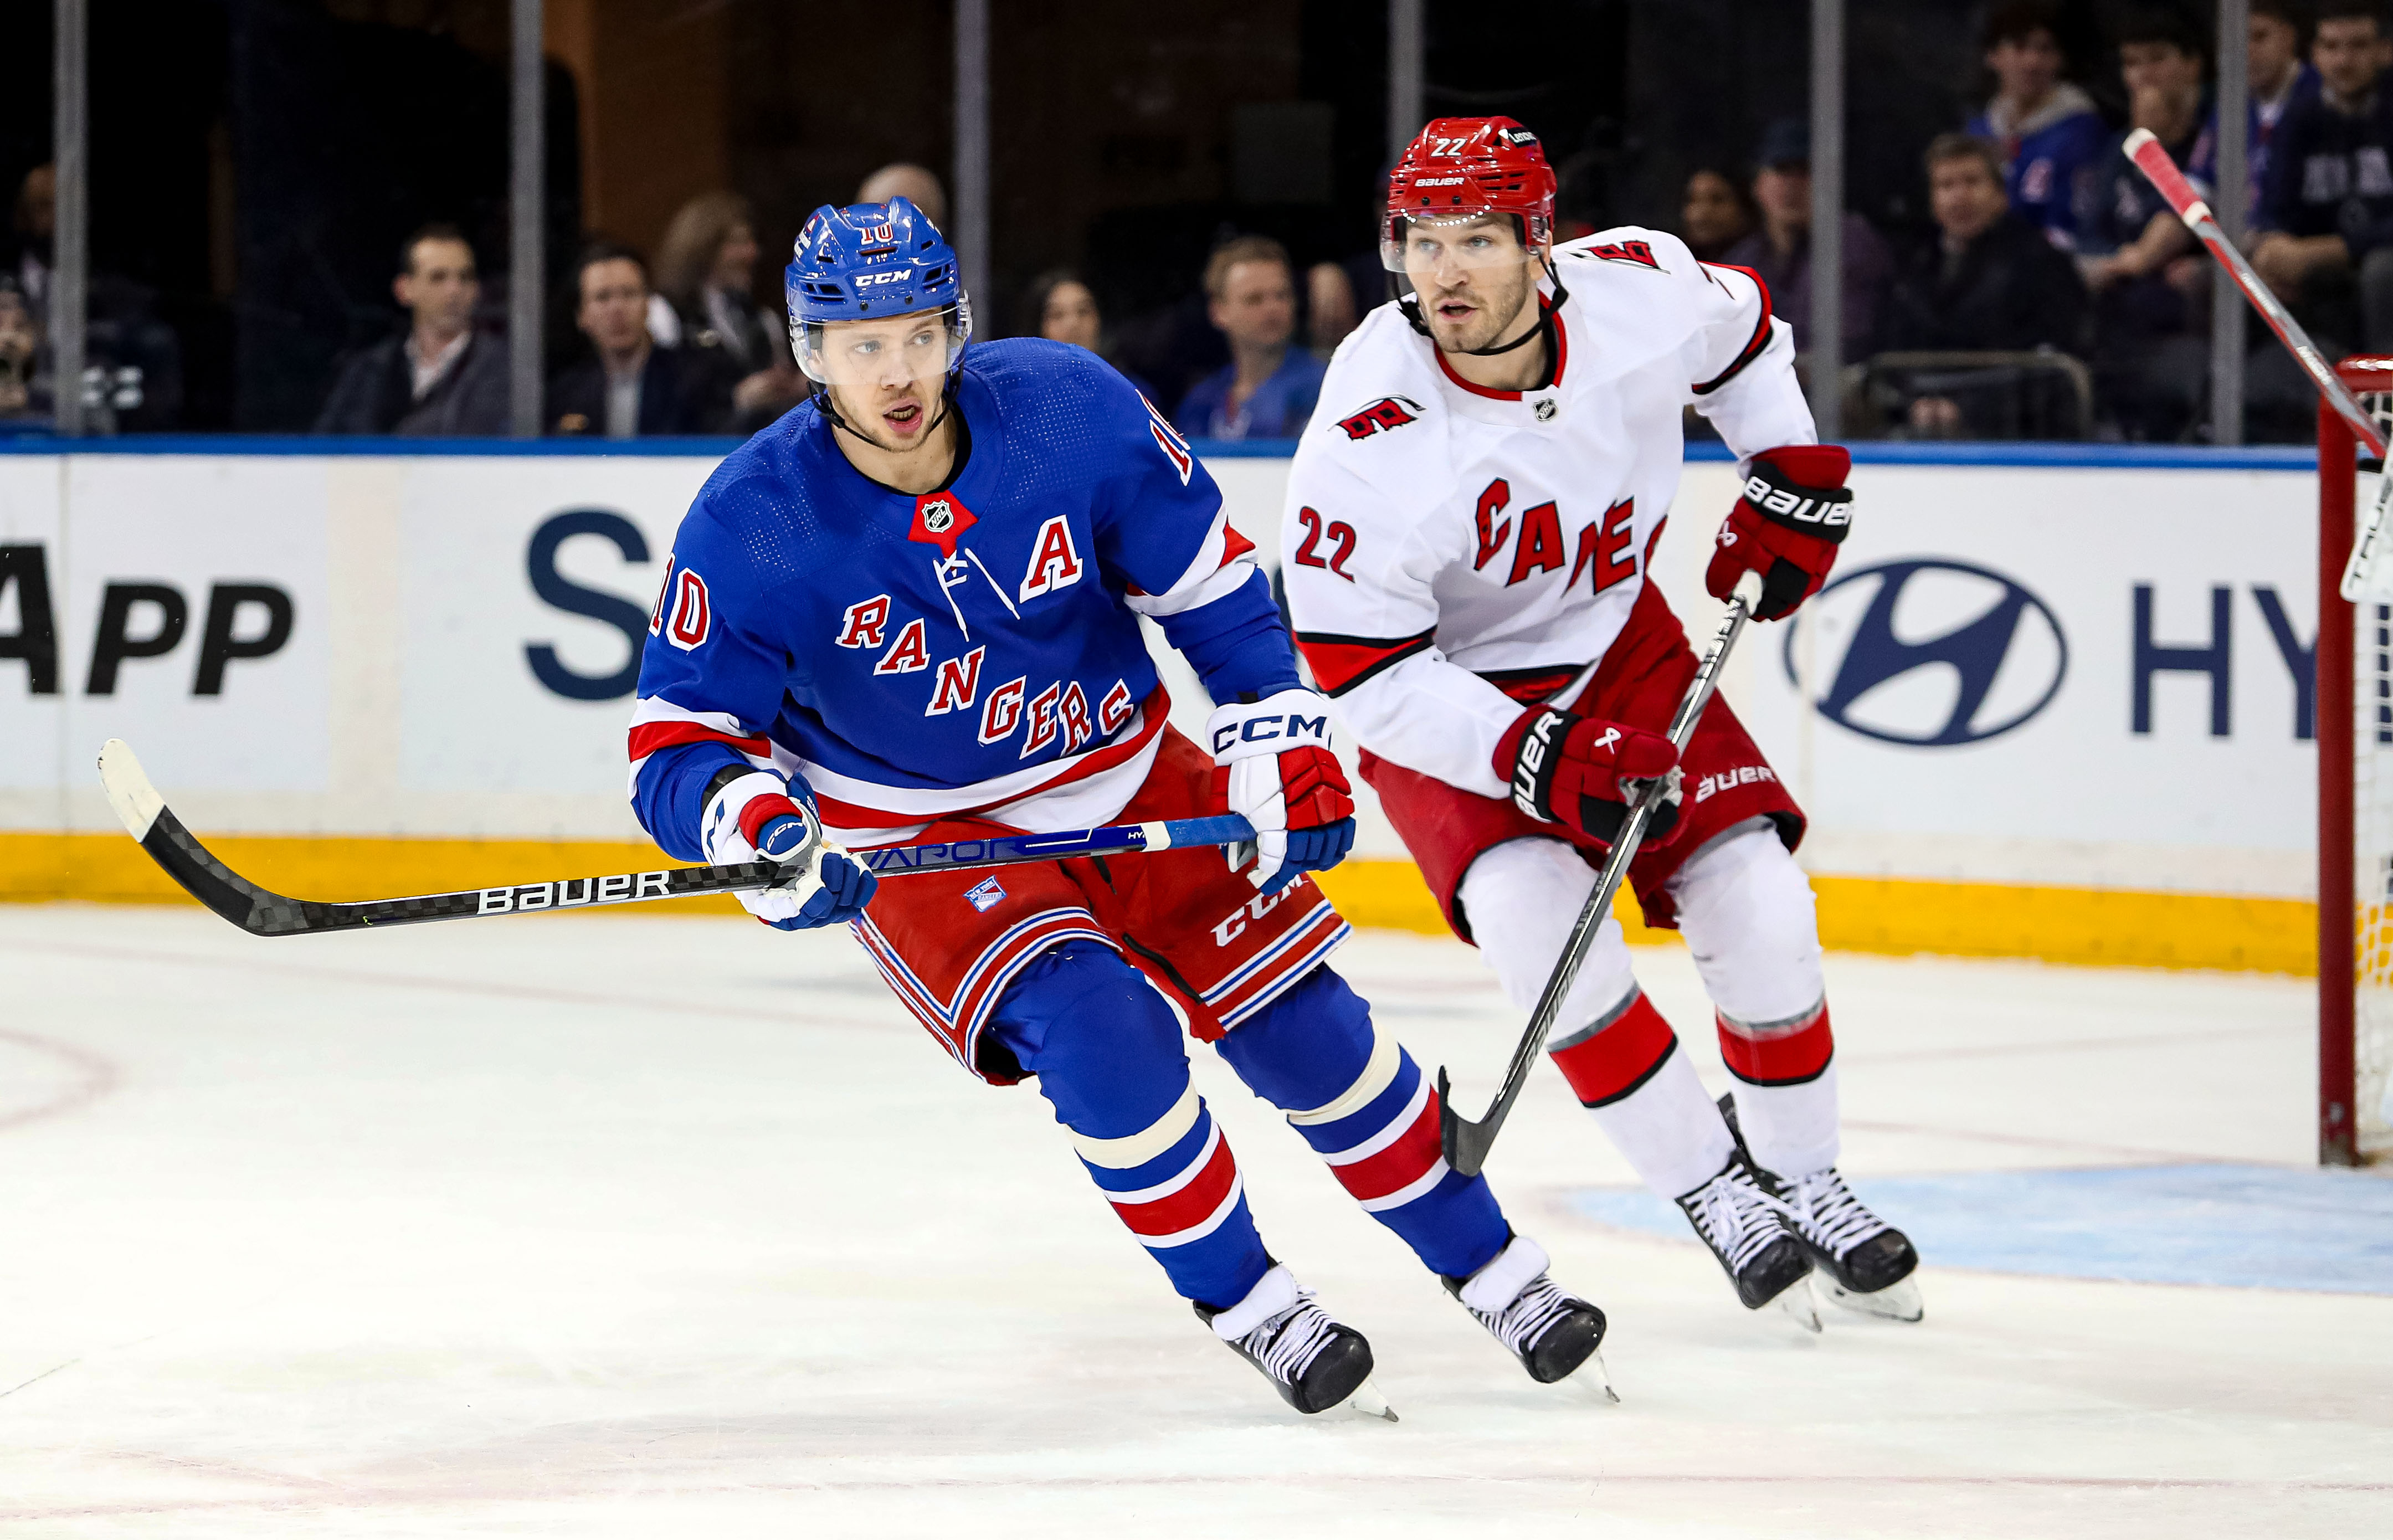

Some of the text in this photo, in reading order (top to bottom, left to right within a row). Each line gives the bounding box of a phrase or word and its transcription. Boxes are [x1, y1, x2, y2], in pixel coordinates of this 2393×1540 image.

[1430, 137, 1467, 157] 22
[1414, 177, 1465, 187] BAUER
[860, 224, 893, 245] 10
[855, 269, 912, 287] CCM
[931, 509, 947, 527] NHL
[1743, 476, 1853, 526] BAUE
[1295, 505, 1357, 583] 22
[1473, 476, 1668, 596] CANE
[1020, 514, 1082, 603] A
[648, 552, 711, 653] 10
[1213, 714, 1328, 755] CCM
[1514, 711, 1564, 824] AUER
[1695, 766, 1778, 804] AUER
[766, 822, 803, 851] CCM
[475, 869, 671, 916] BAUER
